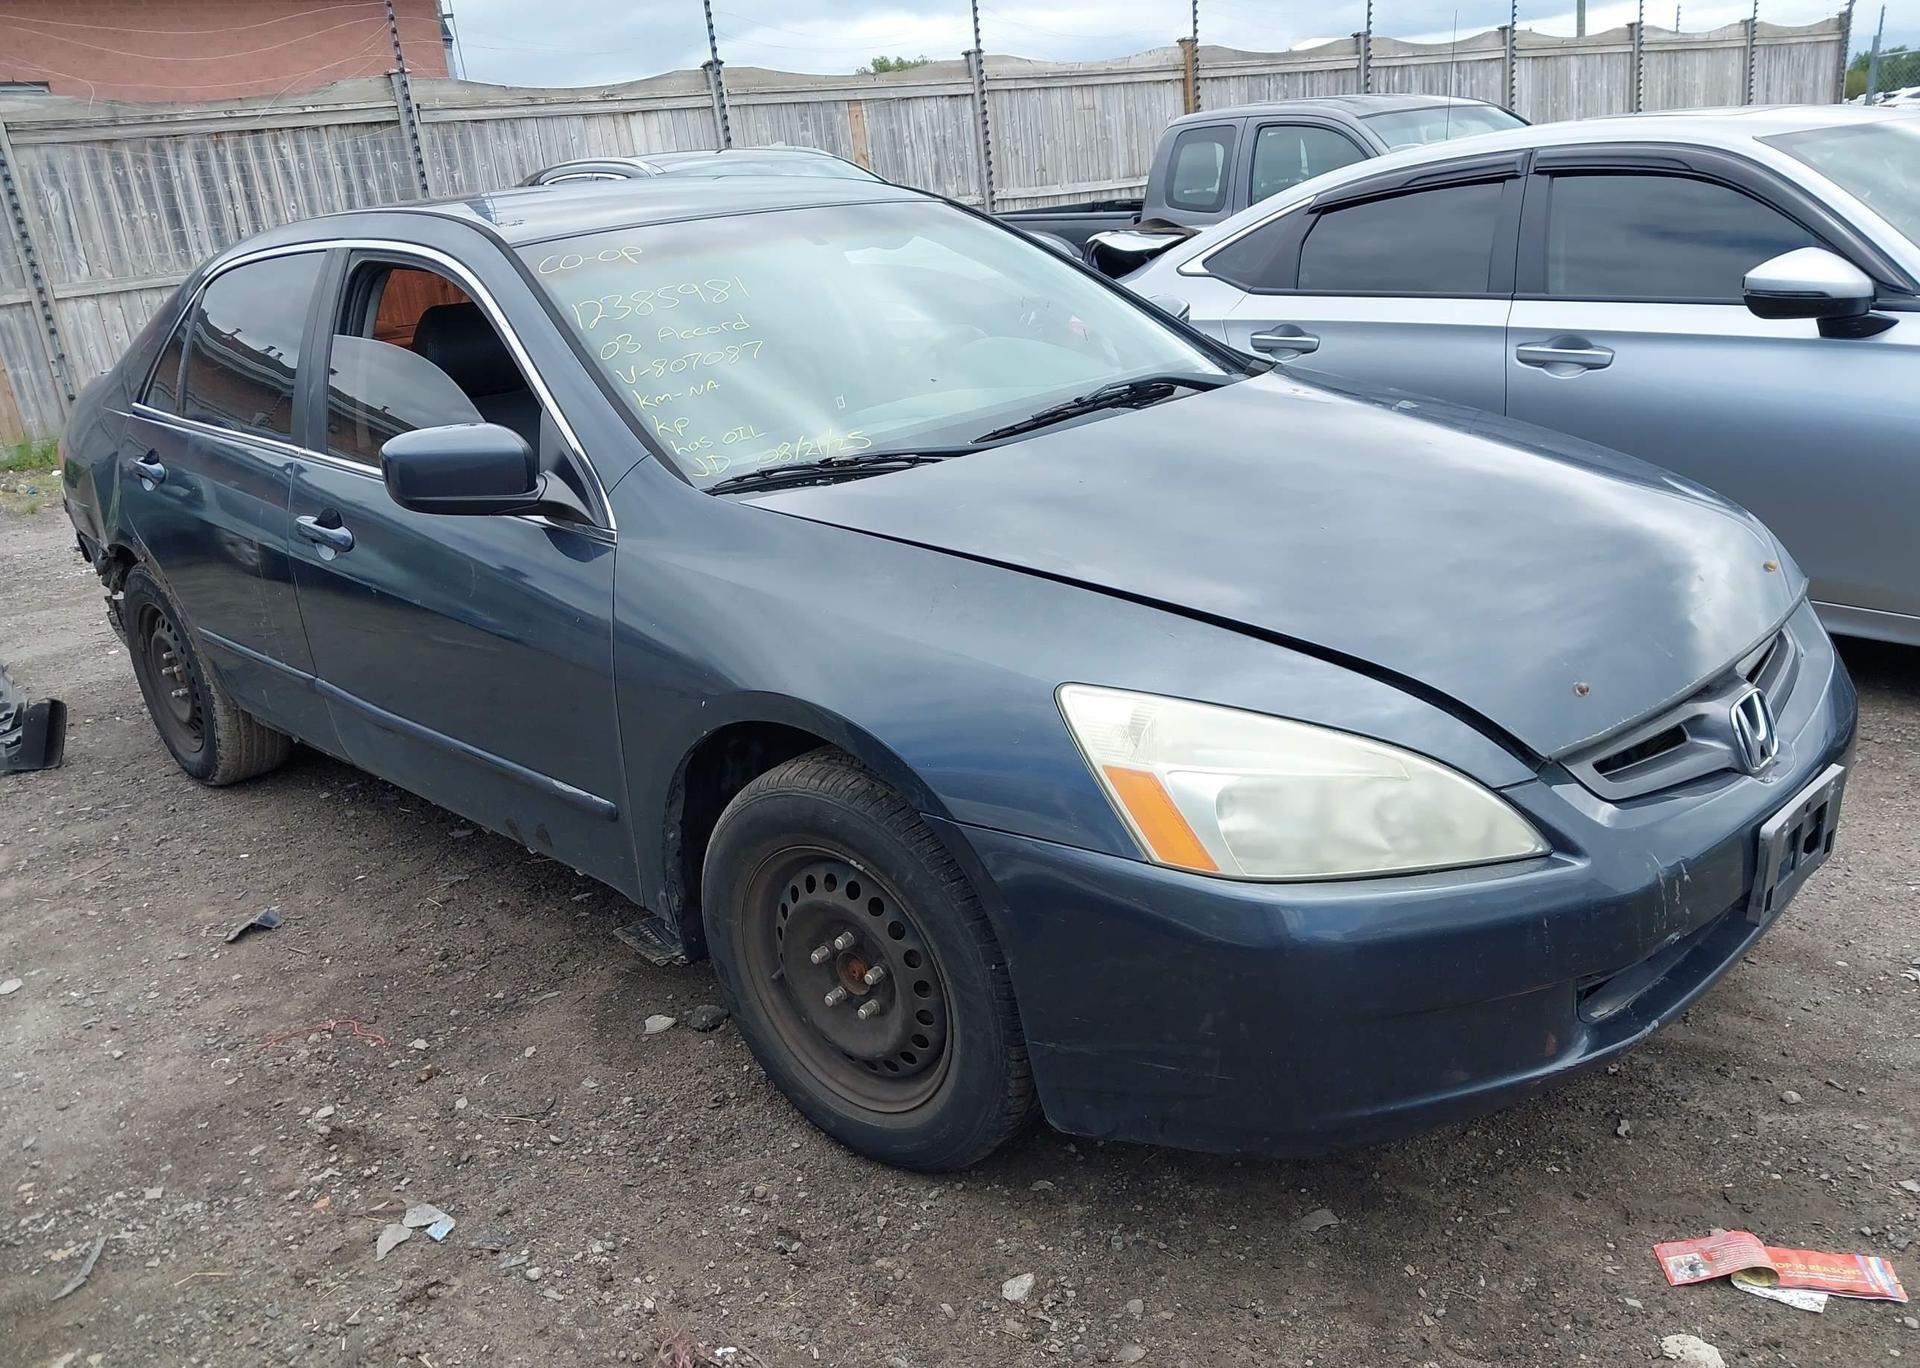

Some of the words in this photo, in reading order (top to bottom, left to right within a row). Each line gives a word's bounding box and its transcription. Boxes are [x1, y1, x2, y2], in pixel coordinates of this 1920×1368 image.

[572, 276, 750, 330] 12385981
[600, 333, 642, 360] 03
[657, 313, 750, 343] Accord
[722, 425, 768, 445] OIL
